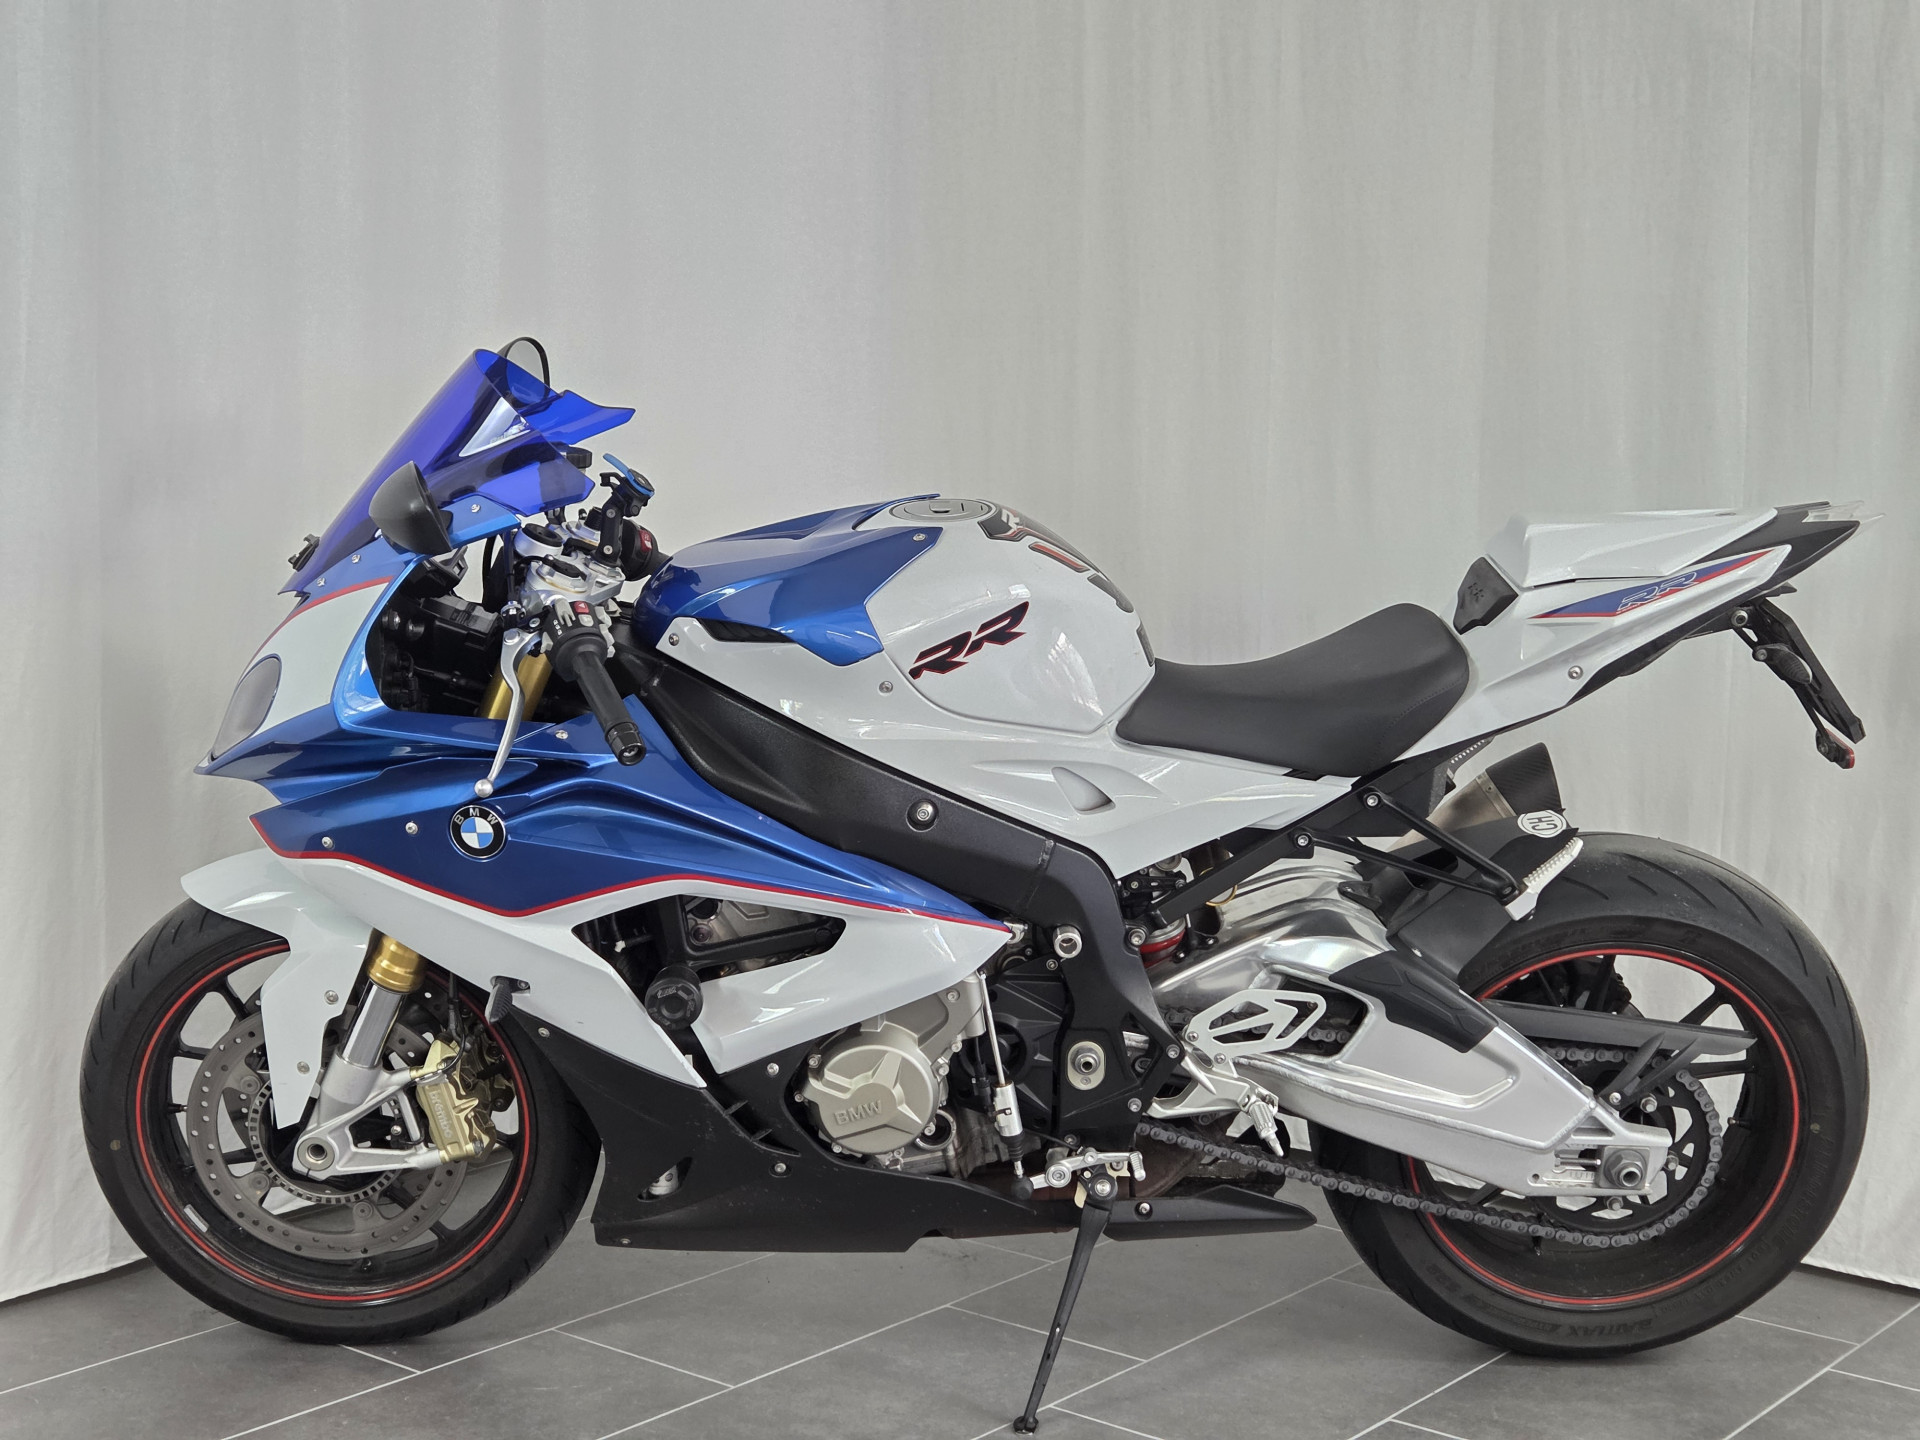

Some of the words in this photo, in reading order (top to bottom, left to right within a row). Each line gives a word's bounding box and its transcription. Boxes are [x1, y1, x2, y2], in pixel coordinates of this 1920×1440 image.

[1617, 571, 1700, 611] RR
[908, 600, 1029, 680] RR
[454, 807, 499, 825] BMW
[1526, 815, 1558, 831] CH
[428, 1089, 453, 1138] brembo
[834, 1100, 881, 1125] BMW
